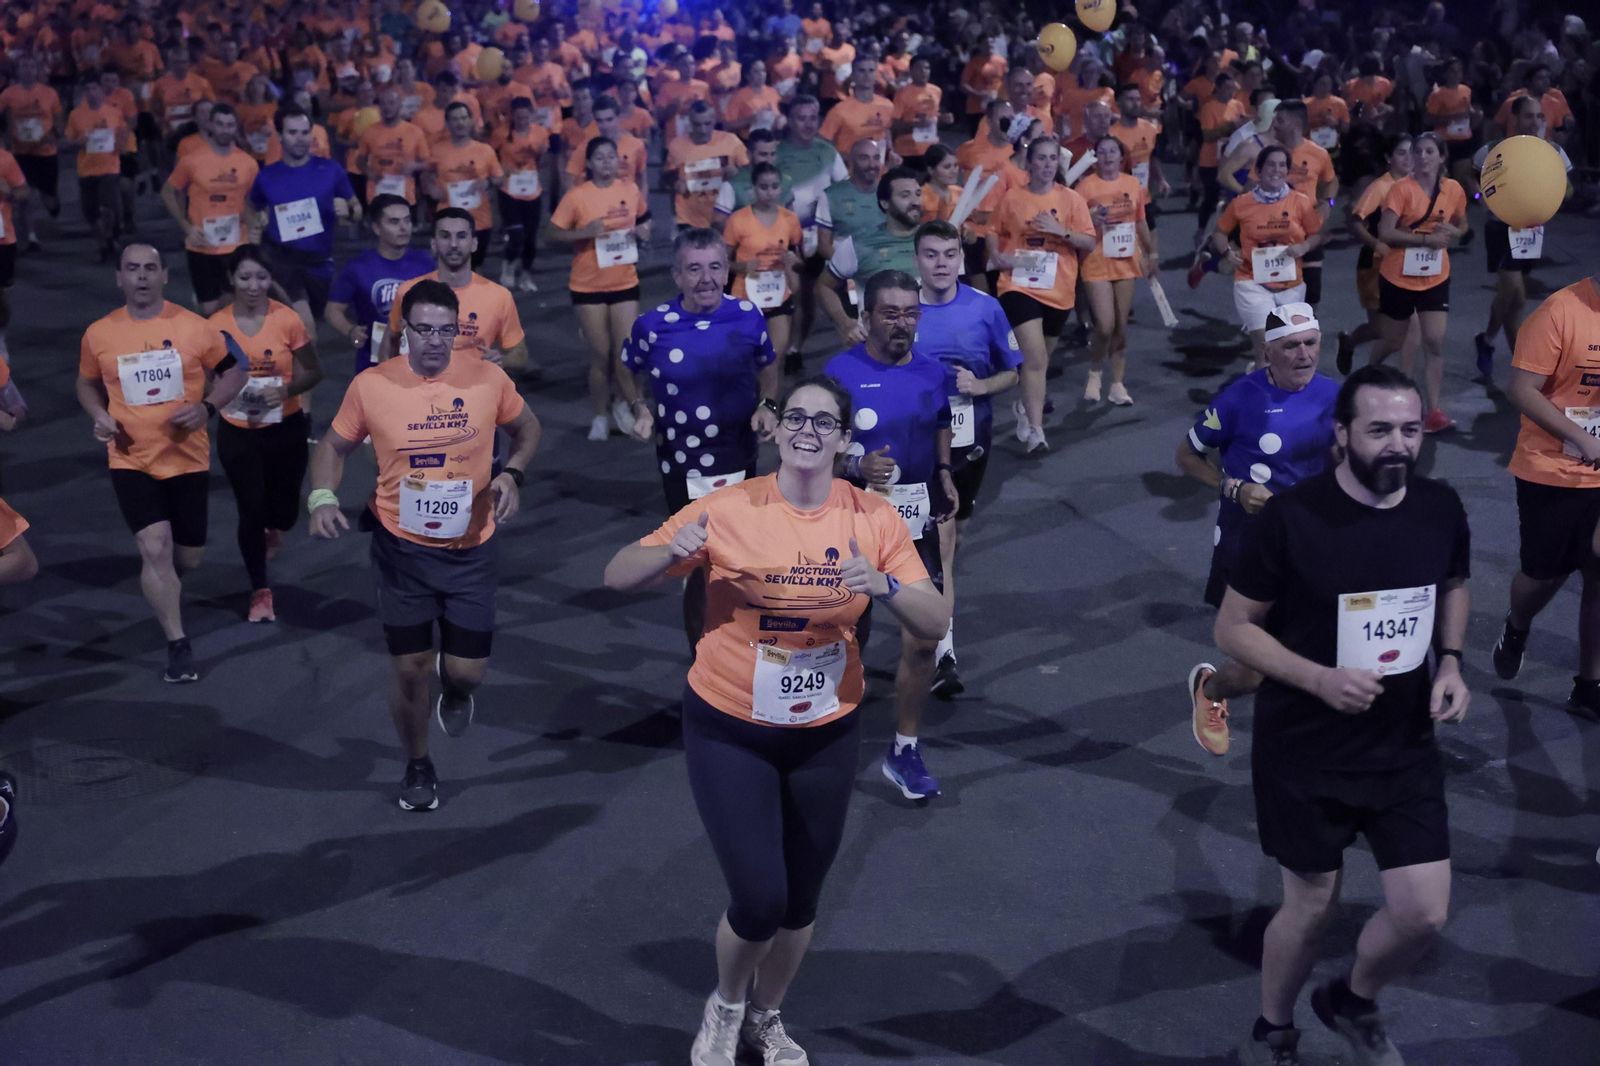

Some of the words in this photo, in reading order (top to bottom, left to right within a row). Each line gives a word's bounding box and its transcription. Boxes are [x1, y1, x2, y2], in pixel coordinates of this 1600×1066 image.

[134, 367, 172, 383] 17804
[426, 412, 469, 421] NOCTURNA
[407, 421, 445, 431] SEVILLA
[415, 499, 459, 515] 11209
[893, 504, 920, 520] 564
[764, 574, 814, 586] SEVILLA
[1363, 616, 1418, 641] 14347
[781, 671, 825, 694] 9249
